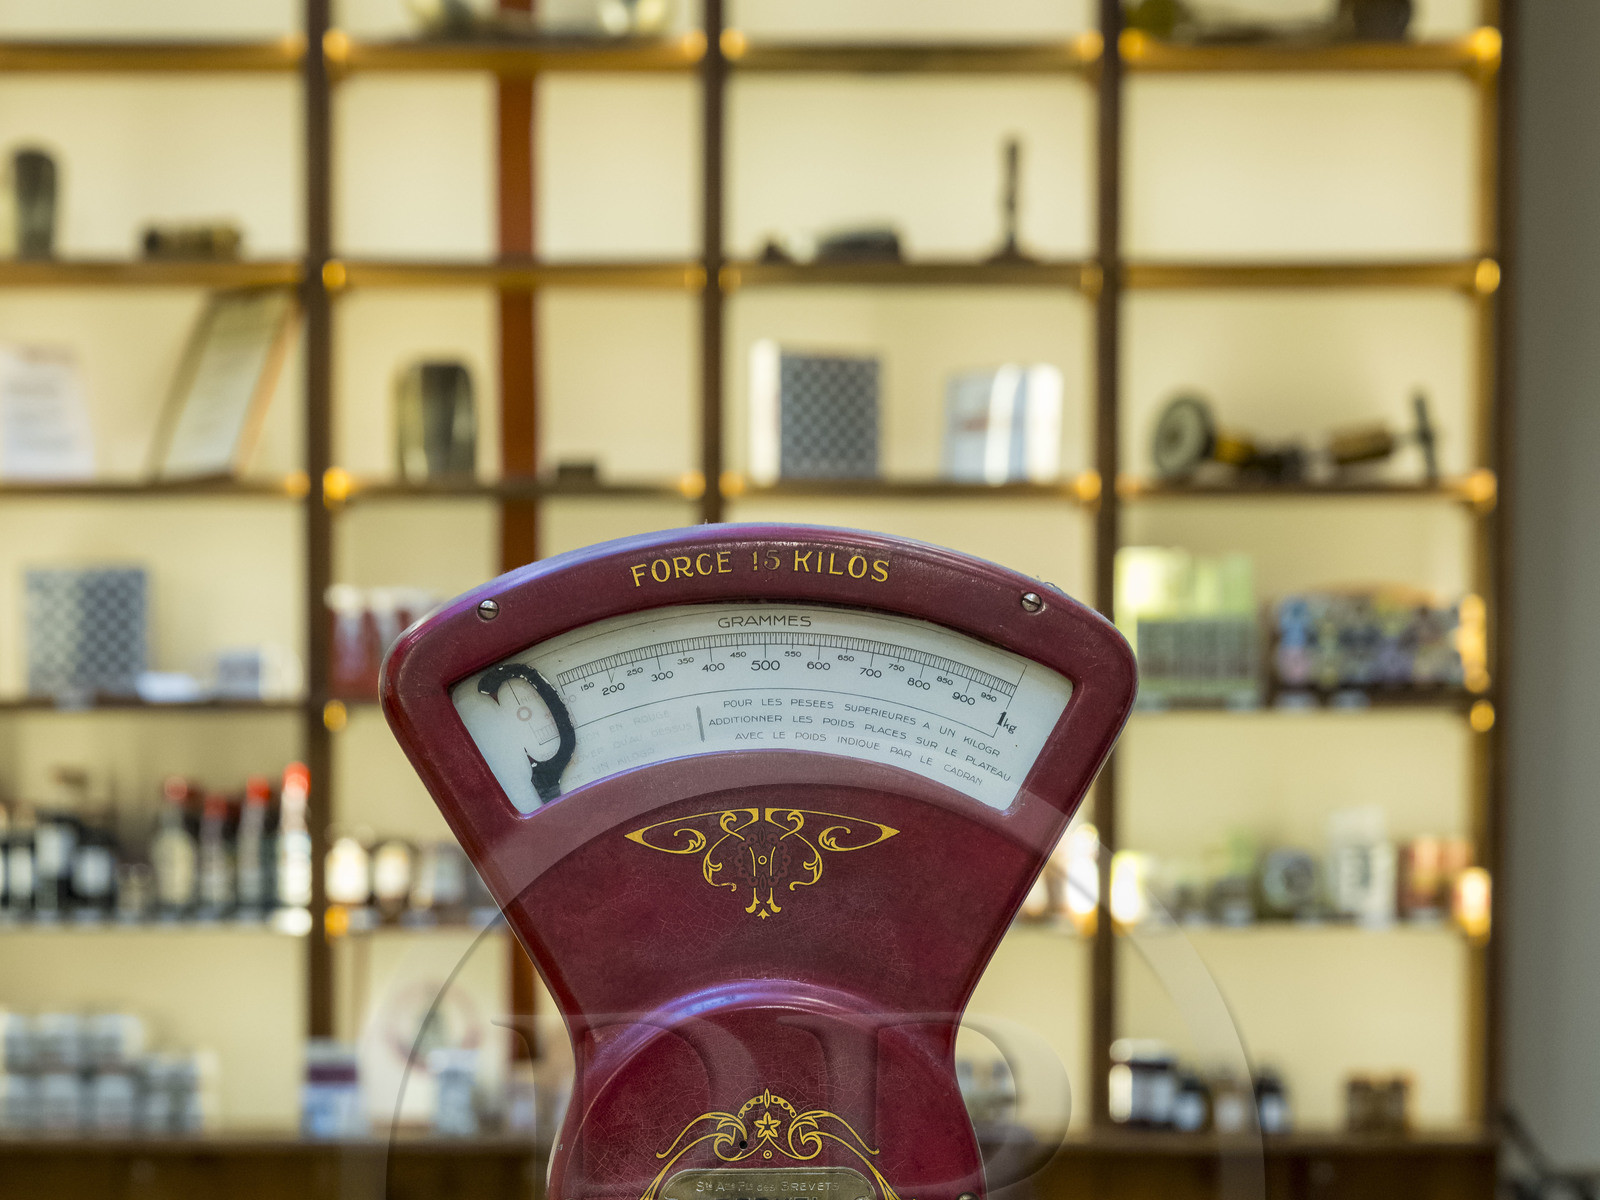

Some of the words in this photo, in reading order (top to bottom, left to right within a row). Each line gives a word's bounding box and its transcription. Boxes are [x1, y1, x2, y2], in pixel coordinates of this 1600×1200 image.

[630, 550, 733, 587] FORCE
[793, 550, 891, 582] KILOS
[717, 615, 812, 628] GRAMMES
[784, 650, 802, 658] 550
[837, 654, 855, 663] 650
[677, 657, 695, 666] 350
[701, 662, 726, 672] 400
[750, 660, 781, 672] 500
[806, 661, 831, 671] 600
[888, 663, 905, 672] 750
[626, 667, 644, 677] 250
[650, 670, 674, 683] 300
[859, 667, 882, 679] 700
[907, 677, 931, 691] 800
[936, 675, 954, 686] 850
[580, 682, 595, 692] 150
[601, 682, 626, 696] 200
[952, 691, 976, 706] 900
[980, 691, 998, 702] 950
[723, 699, 753, 708] POUR
[761, 698, 783, 706] LES
[790, 698, 834, 709] PESEES
[844, 703, 916, 726] SUPERIEURES
[922, 722, 931, 730] A
[939, 725, 956, 738] UN
[962, 736, 1001, 757] KILOGR
[708, 714, 783, 727] ADDITIONNER
[792, 715, 813, 724] LES
[822, 717, 855, 728] POIDS
[864, 723, 907, 740] PLACES
[915, 736, 938, 749] SUR
[944, 746, 958, 757] LE
[965, 754, 1012, 782] PLATEAU
[734, 731, 764, 740] AVEC
[772, 731, 786, 739] LE
[795, 731, 827, 742] POIDS
[837, 736, 881, 751] INDIQUE
[889, 746, 913, 759] PAR
[919, 755, 933, 766] LE
[943, 764, 983, 786] CADRAN
